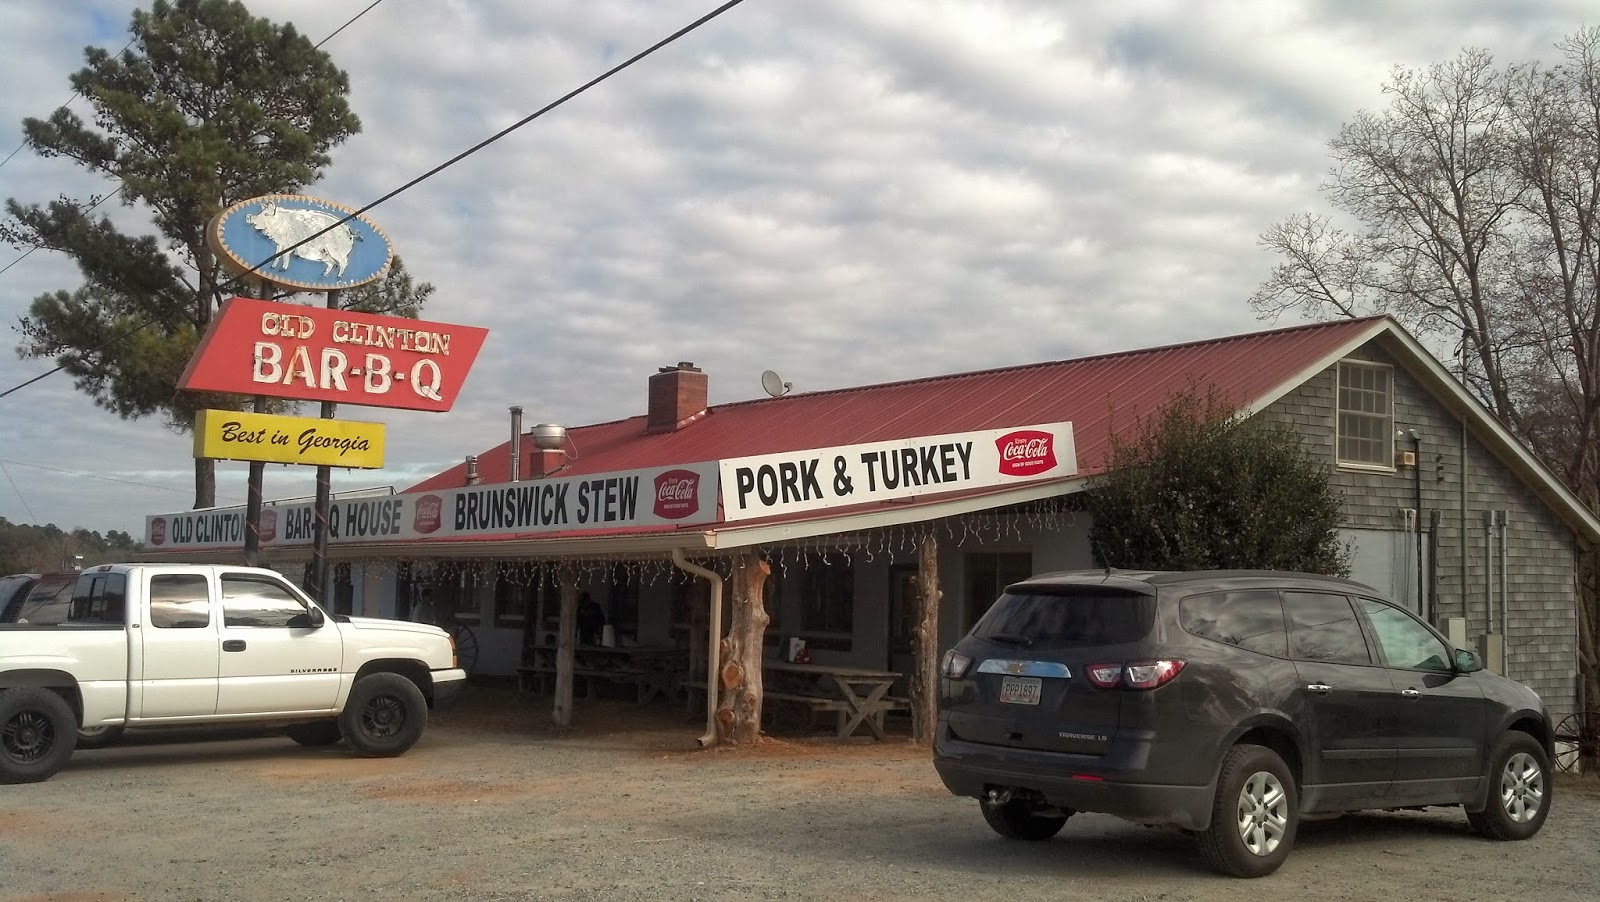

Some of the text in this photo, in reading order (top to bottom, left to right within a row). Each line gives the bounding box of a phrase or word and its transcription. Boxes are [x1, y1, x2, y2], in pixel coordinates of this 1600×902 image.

[262, 312, 451, 356] OLD CLINTON
[253, 341, 443, 401] BAR-B-Q
[222, 421, 370, 457] Best in Georgia
[736, 441, 974, 510] PORK & TURKEY
[285, 504, 340, 540] BAR-Q
[345, 500, 403, 537] HOUSE
[454, 476, 640, 531] BRUNSWICK STEW
[172, 516, 193, 544] OLD
[1058, 731, 1096, 741] TRAVERSE
